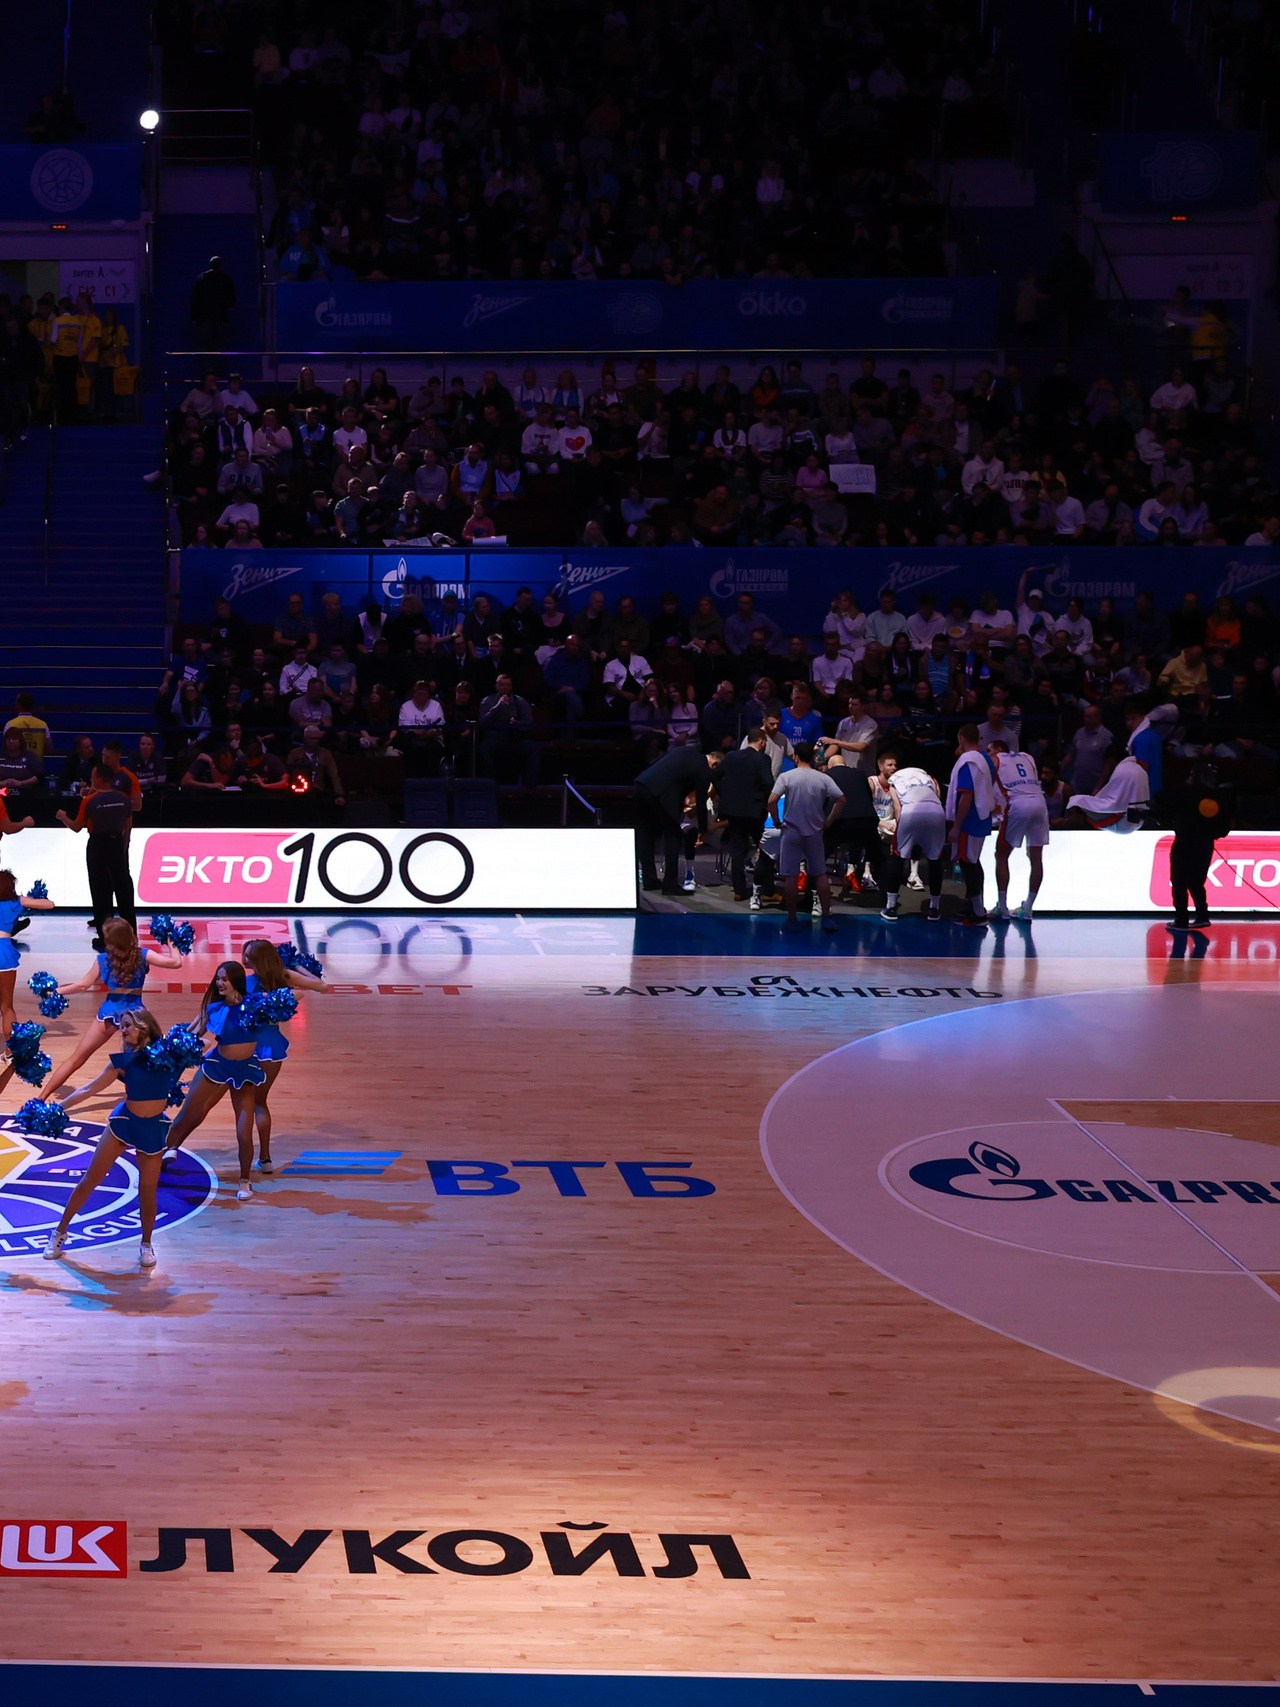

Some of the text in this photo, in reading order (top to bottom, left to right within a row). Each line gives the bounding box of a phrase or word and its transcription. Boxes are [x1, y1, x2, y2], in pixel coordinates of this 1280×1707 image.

[98, 266, 105, 278] А
[736, 568, 789, 583] ГАЗПРОМ
[1070, 582, 1136, 598] ГАЗПРОМ
[1016, 763, 1027, 778] 6
[157, 832, 474, 904] ЭКТО 100
[1204, 859, 1280, 888] КТО
[581, 985, 1004, 999] ЗАРУБЕЖНЕФТЬ
[427, 1159, 716, 1198] ВТБ
[1055, 1179, 1280, 1204] GAZPR
[140, 1521, 752, 1580] ЛУКОЙЛ
